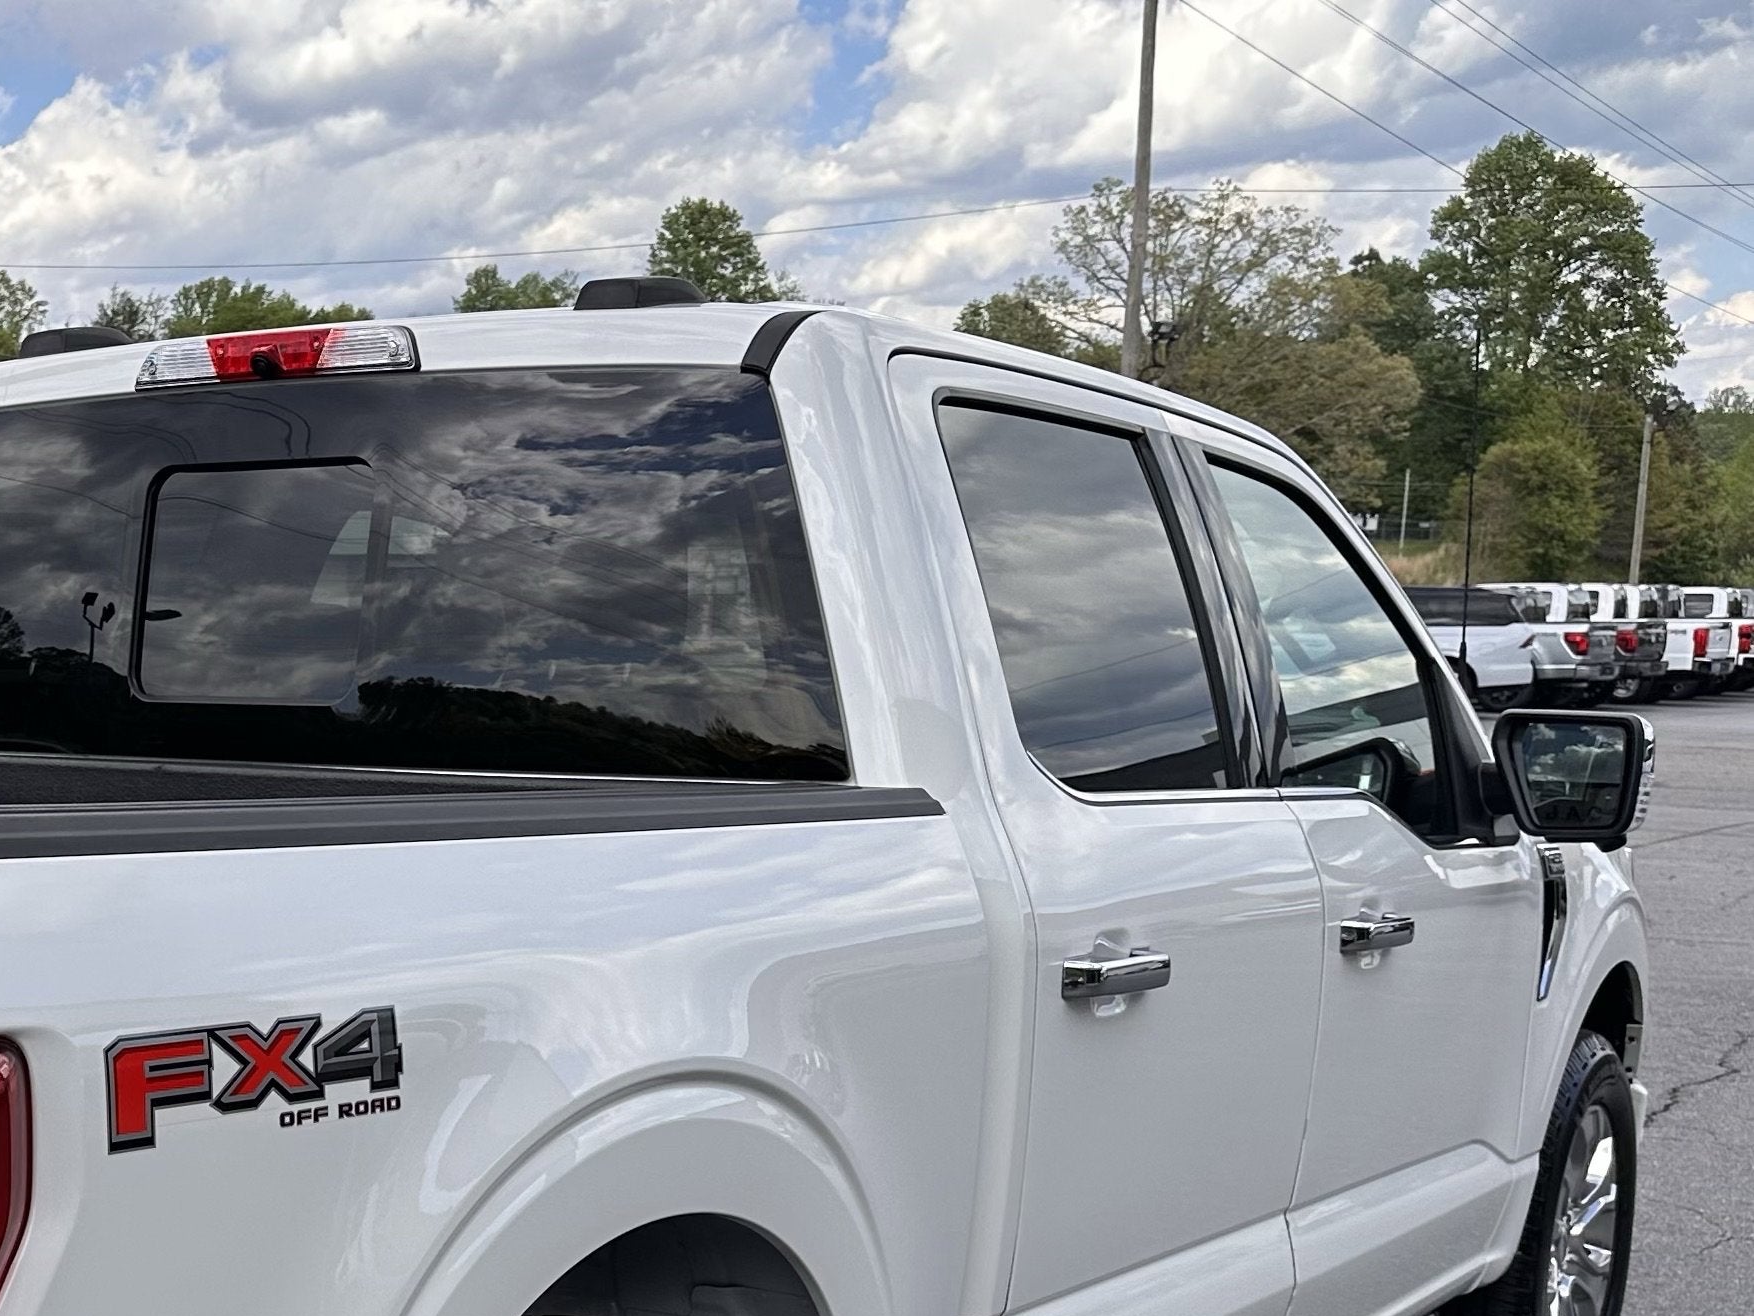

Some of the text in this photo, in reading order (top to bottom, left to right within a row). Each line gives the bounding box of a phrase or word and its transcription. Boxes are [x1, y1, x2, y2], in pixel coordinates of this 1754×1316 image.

[103, 1005, 403, 1156] FX4
[279, 1095, 401, 1128] OFF ROAD
